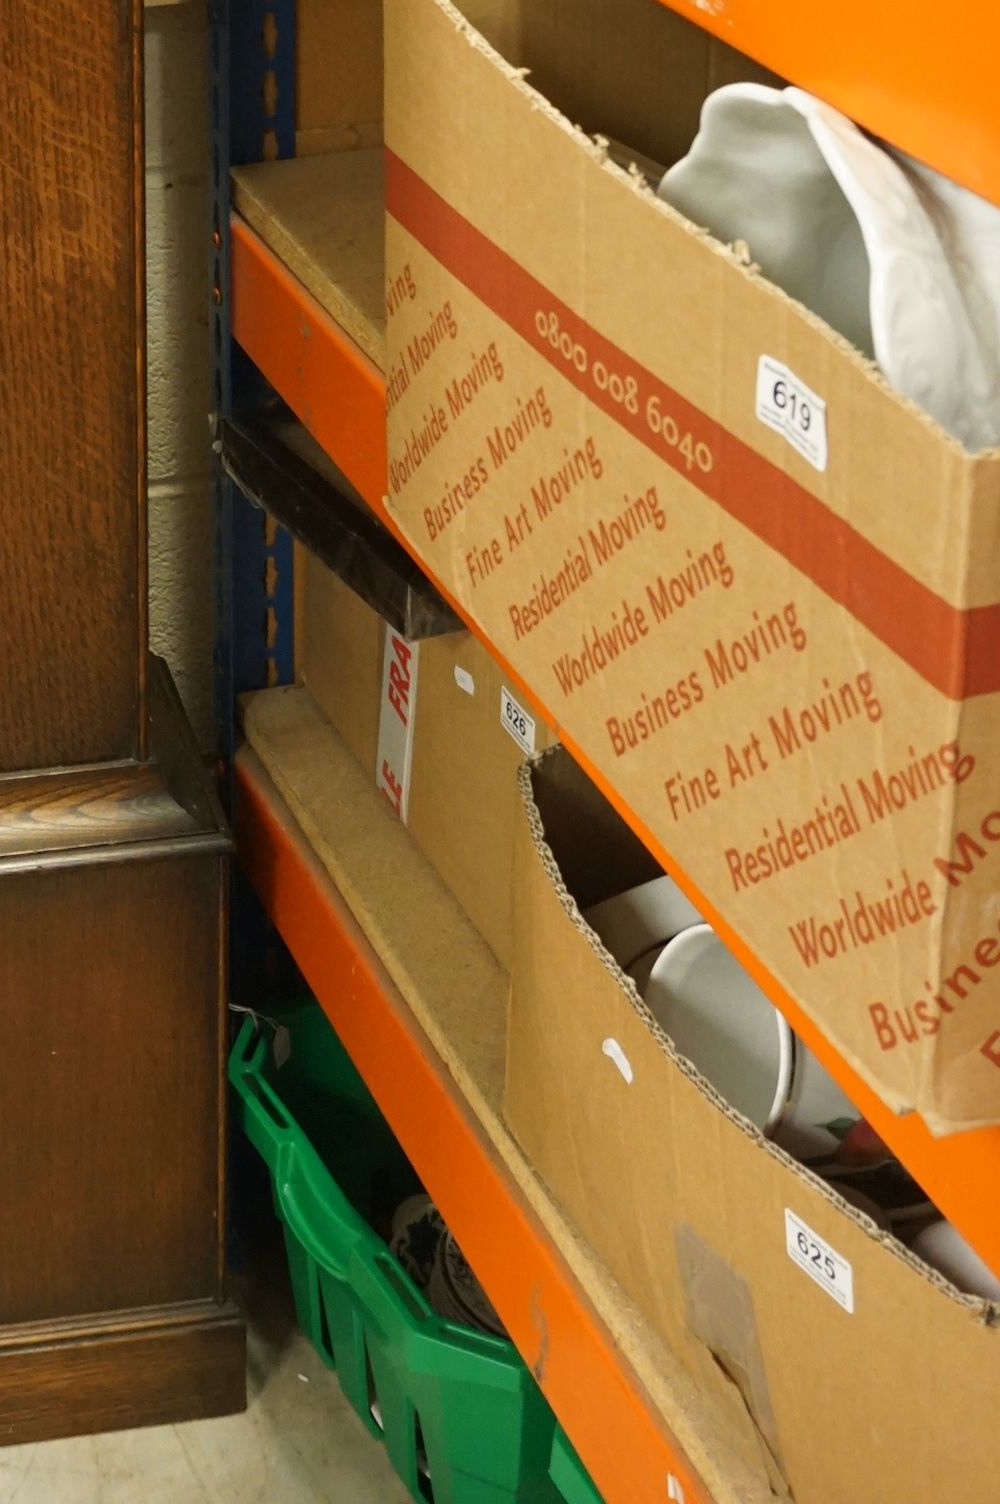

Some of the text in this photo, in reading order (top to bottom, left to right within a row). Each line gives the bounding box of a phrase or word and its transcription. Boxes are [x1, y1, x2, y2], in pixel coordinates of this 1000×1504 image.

[407, 300, 457, 376] Moving
[535, 310, 588, 373] 0800
[592, 362, 639, 415] 008
[646, 396, 714, 473] 6040
[773, 380, 811, 431] 619
[389, 342, 504, 495] Worldwide Moving
[423, 386, 553, 541] Business Moving
[465, 436, 604, 589] Fine Art Moving
[508, 485, 667, 641] Residential Moving
[552, 541, 735, 697] Worldwide Moving
[606, 671, 704, 758] Business
[704, 602, 807, 690] Moving
[506, 702, 527, 736] 626
[664, 670, 883, 821] Fine Art Moving
[724, 739, 976, 893] Residential Moving
[788, 869, 938, 969] Worldwide
[869, 918, 1000, 1051] Busine
[797, 1231, 836, 1280] 625
